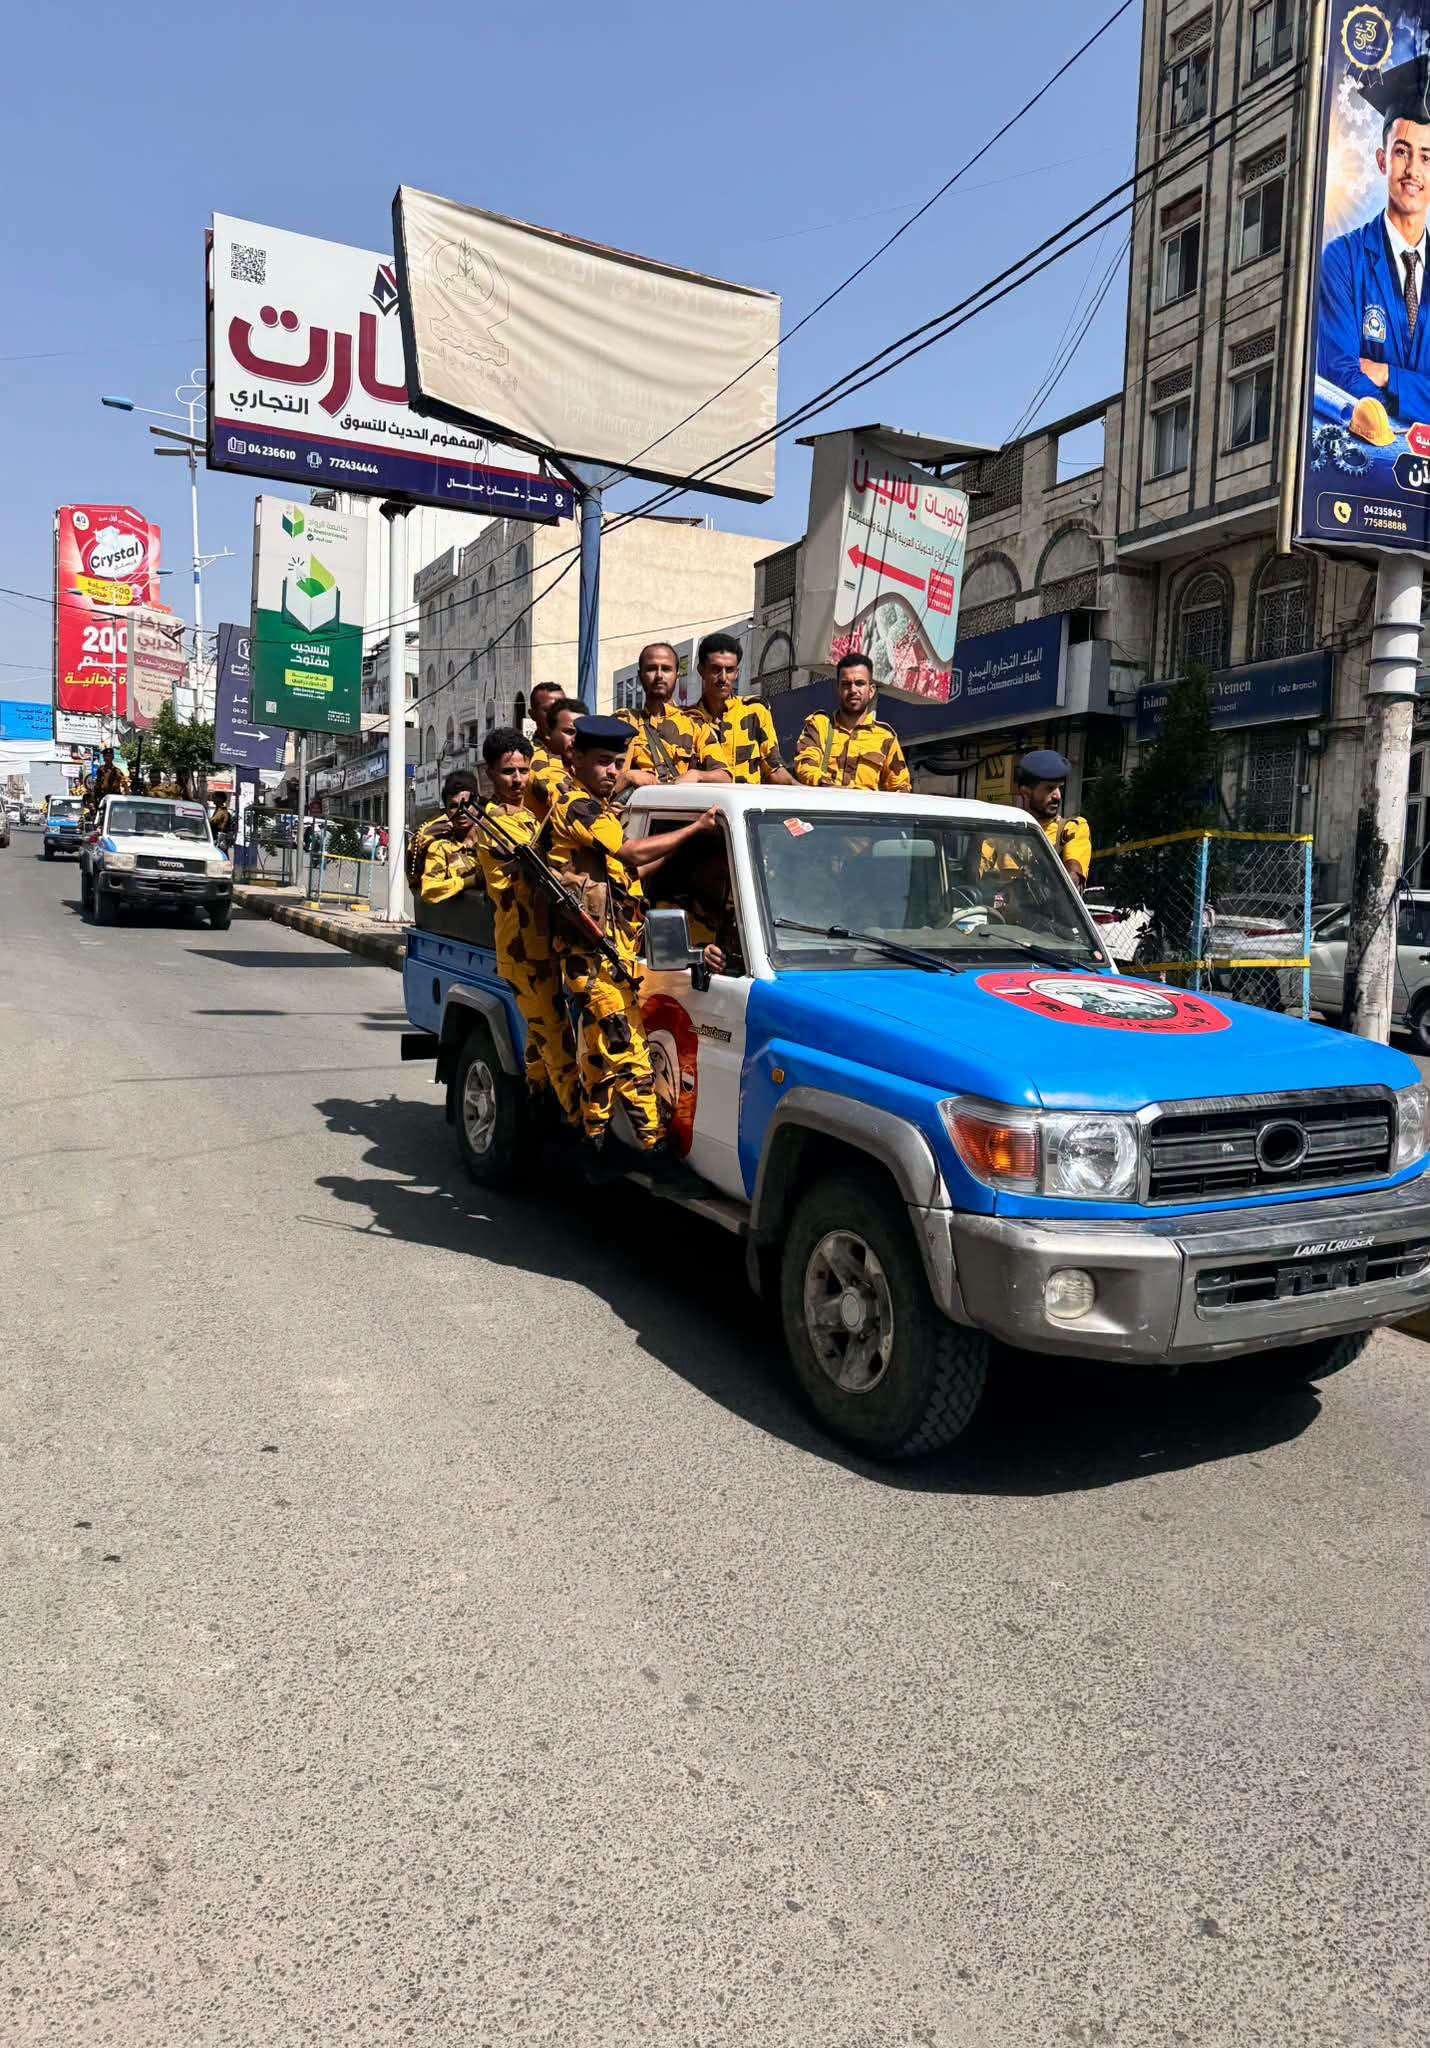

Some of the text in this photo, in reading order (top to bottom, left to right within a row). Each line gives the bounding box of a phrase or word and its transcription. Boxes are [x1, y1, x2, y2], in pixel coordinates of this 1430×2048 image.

[228, 304, 410, 418] ارت
[229, 389, 309, 415] التجاري
[340, 414, 483, 450] المفهوم الحديث للتسوق
[329, 457, 379, 474] 772434444
[446, 478, 485, 494] جمال
[853, 448, 919, 520] ياسين
[924, 493, 966, 527] حلويات
[1363, 504, 1402, 518] 04235843
[1363, 517, 1407, 532] 775858888
[90, 542, 139, 569] Crystal
[967, 669, 1041, 696] Yemen Commercial Bank
[1218, 680, 1252, 697] Yemen
[158, 860, 184, 868] TOYOTA
[1293, 1236, 1376, 1257] LAND CRUISER
